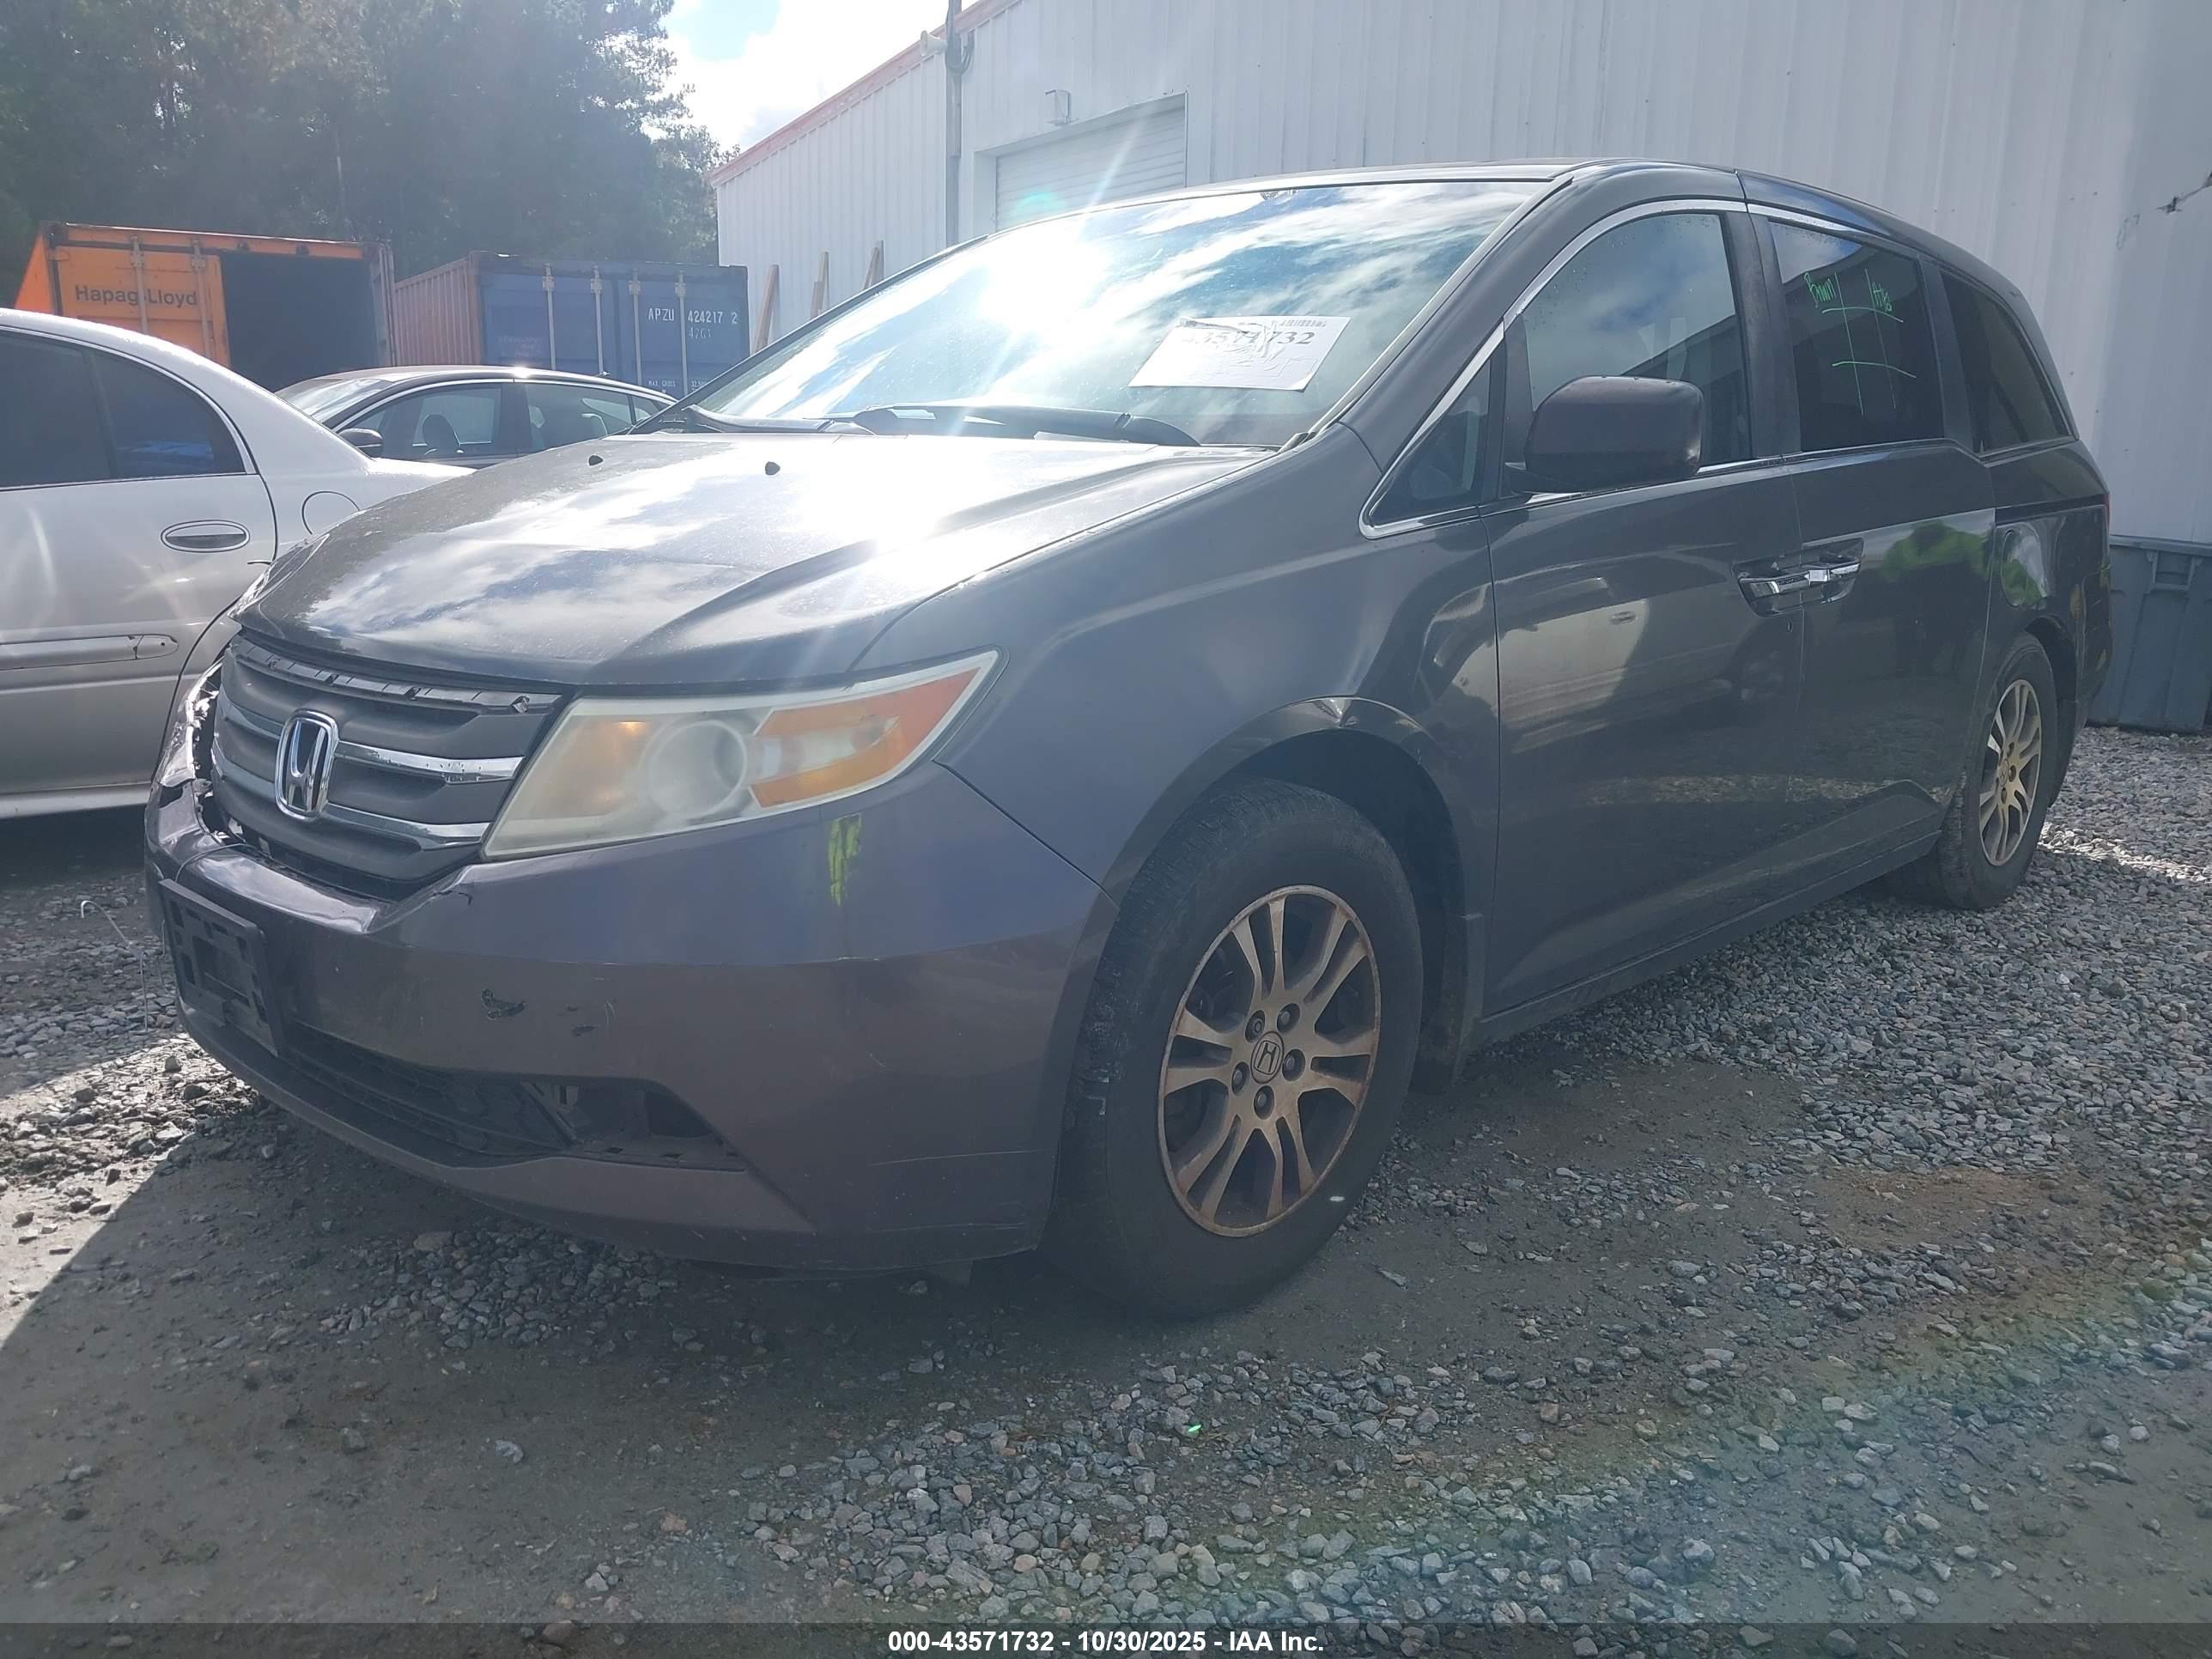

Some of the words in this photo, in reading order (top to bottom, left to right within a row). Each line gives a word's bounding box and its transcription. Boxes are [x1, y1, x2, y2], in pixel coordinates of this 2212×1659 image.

[648, 308, 675, 321] APZU
[688, 310, 723, 324] 424217
[730, 312, 738, 324] 2
